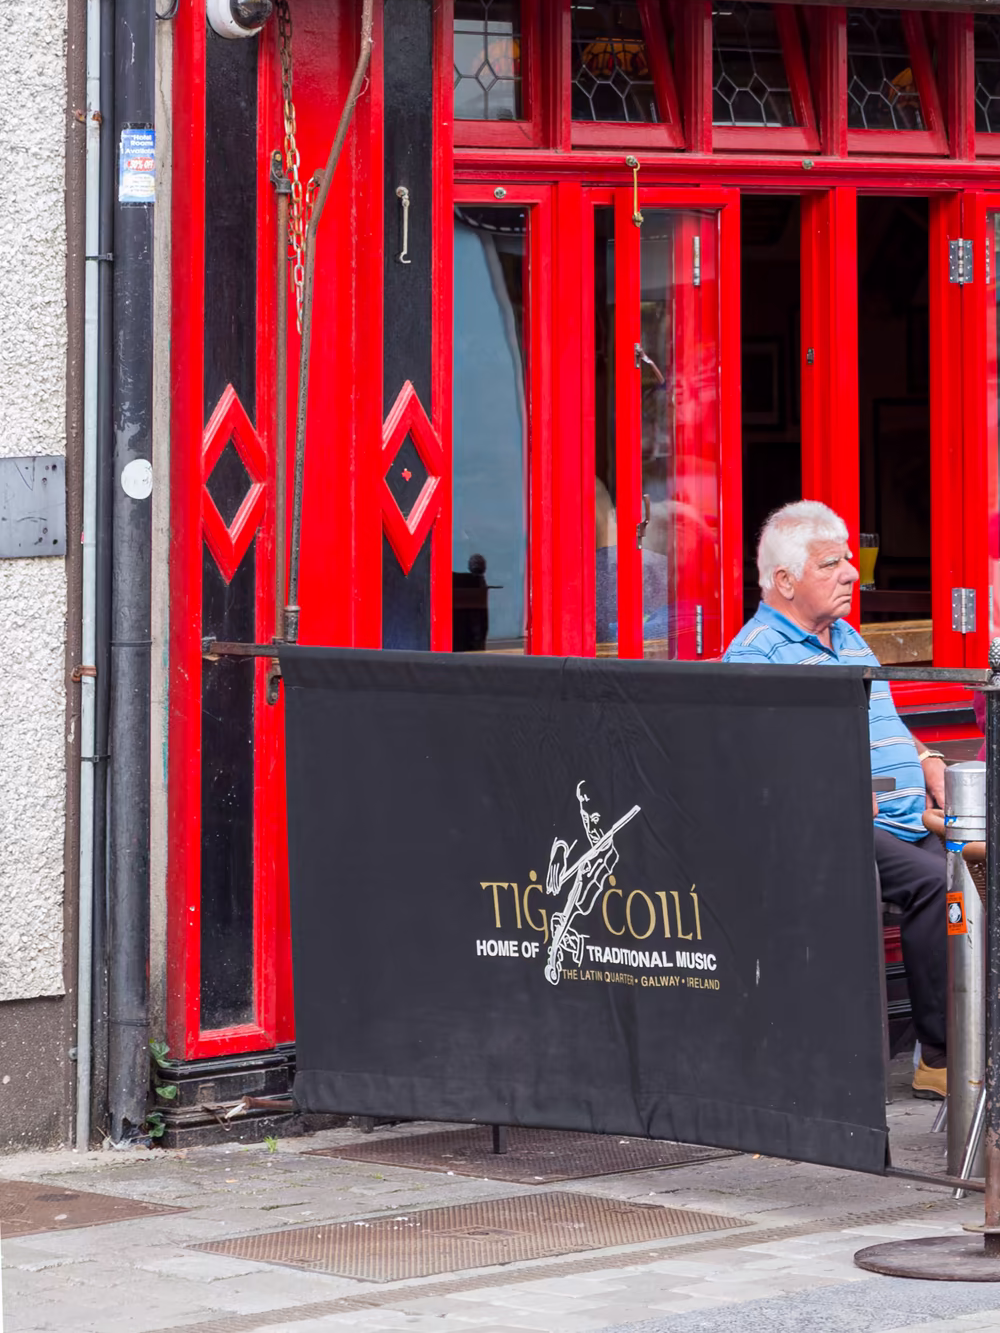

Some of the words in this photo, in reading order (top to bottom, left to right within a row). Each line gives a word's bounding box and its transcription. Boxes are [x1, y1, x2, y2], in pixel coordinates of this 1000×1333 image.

[476, 940, 519, 958] HOME
[521, 941, 540, 958] OF
[586, 945, 673, 968] TRADITIONAL
[675, 951, 717, 971] MUSIC
[562, 969, 578, 980] THE
[580, 970, 603, 981] LATIN
[604, 972, 634, 986] QUARTER
[640, 976, 680, 987] GALWAY
[686, 977, 720, 990] IRELAND
